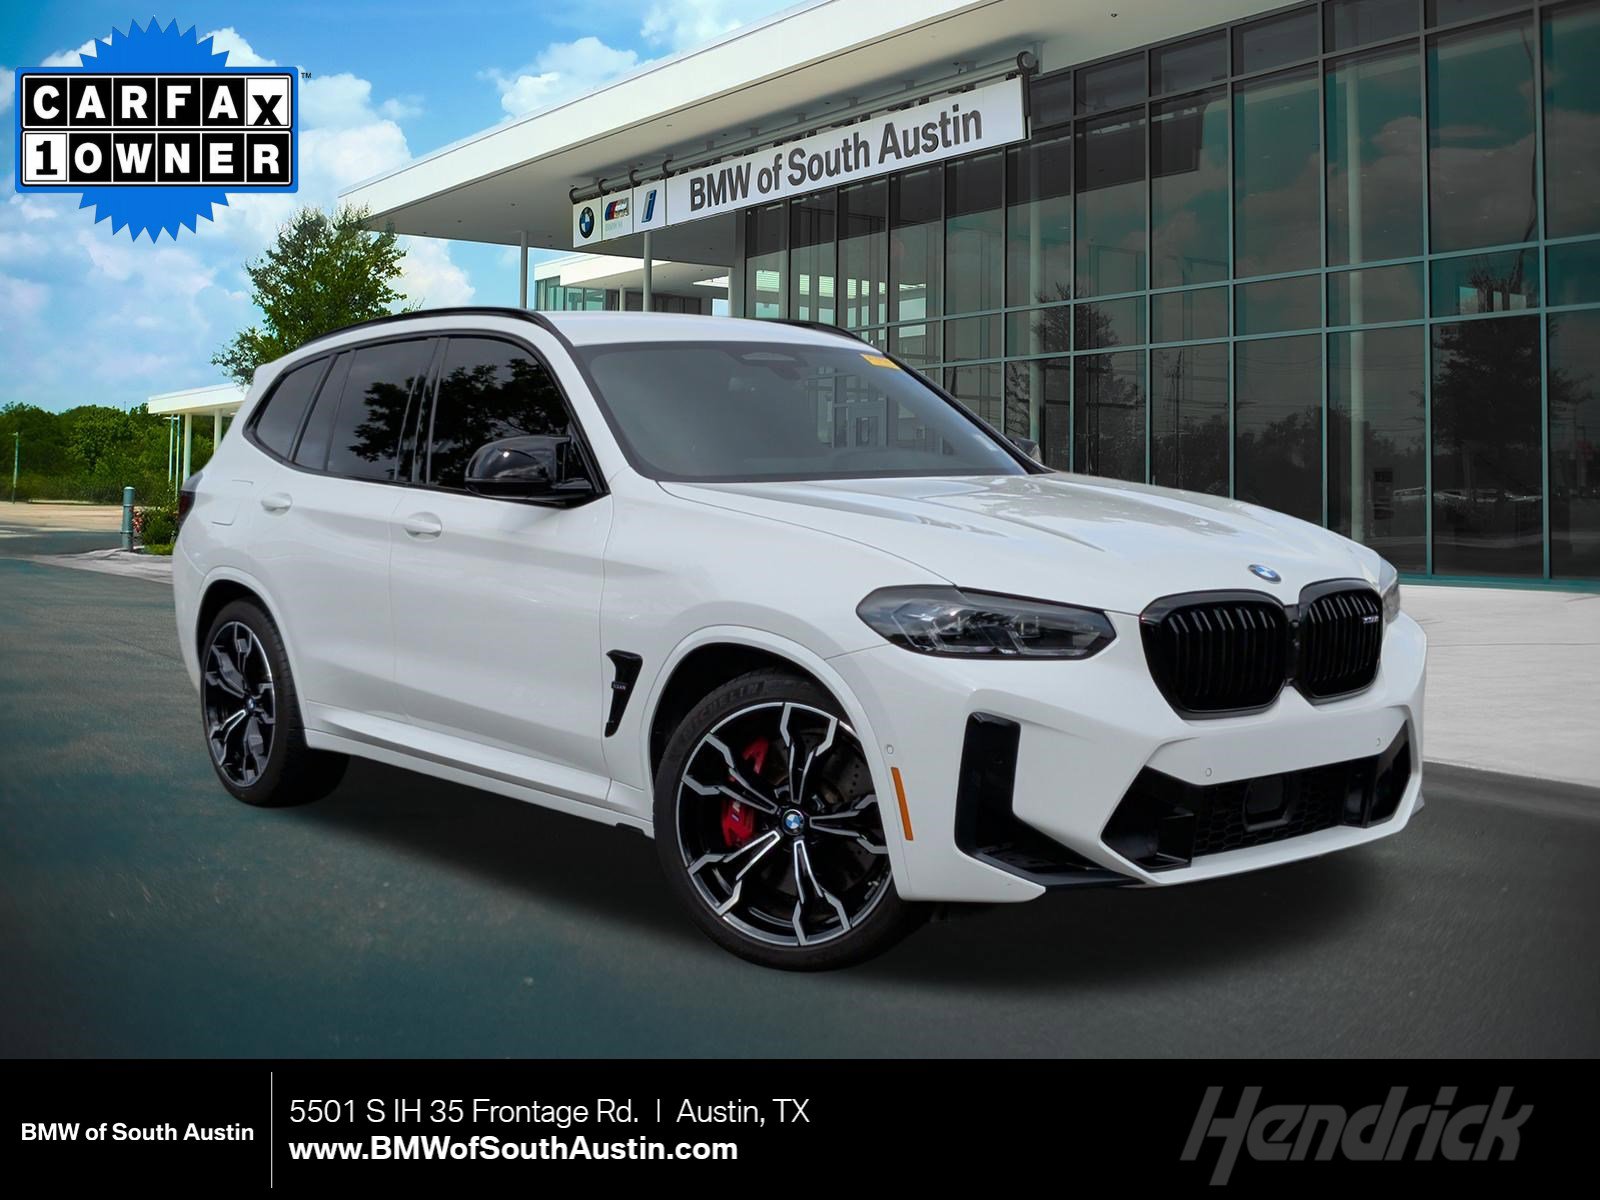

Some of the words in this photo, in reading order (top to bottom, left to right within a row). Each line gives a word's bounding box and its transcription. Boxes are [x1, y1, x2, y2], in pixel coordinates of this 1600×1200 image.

[689, 162, 752, 212] BMW
[757, 153, 783, 194] of
[787, 131, 870, 186] South
[878, 103, 983, 165] Austin
